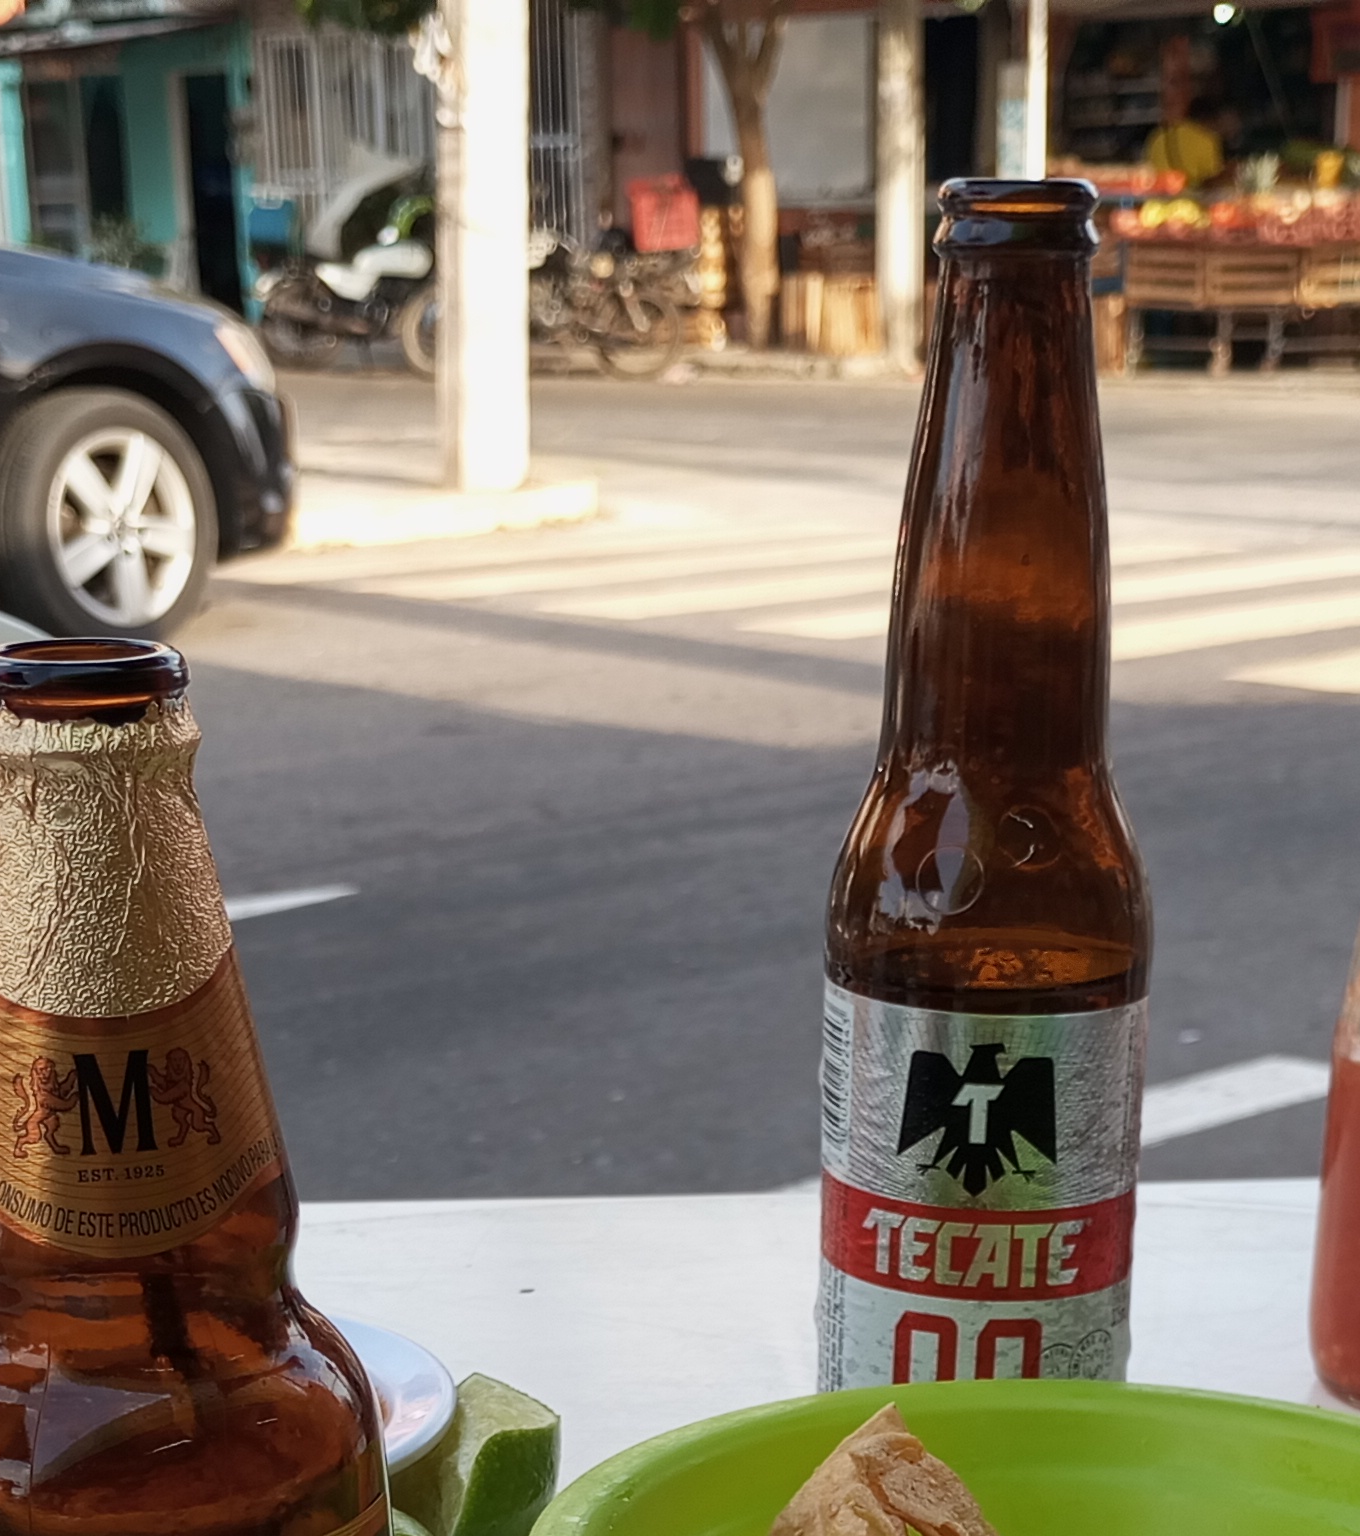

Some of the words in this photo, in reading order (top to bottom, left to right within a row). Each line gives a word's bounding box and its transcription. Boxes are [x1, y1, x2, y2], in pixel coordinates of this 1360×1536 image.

[73, 1050, 158, 1155] M
[951, 1083, 1005, 1144] T
[53, 1207, 75, 1234] DE
[77, 1211, 114, 1238] ESTE
[118, 1196, 199, 1237] PRODUCTO
[196, 1187, 217, 1215] ES
[211, 1154, 253, 1204] NOCIVO
[77, 1169, 119, 1182] EST.
[125, 1164, 165, 1179] 1925
[862, 1207, 1086, 1289] TECATE
